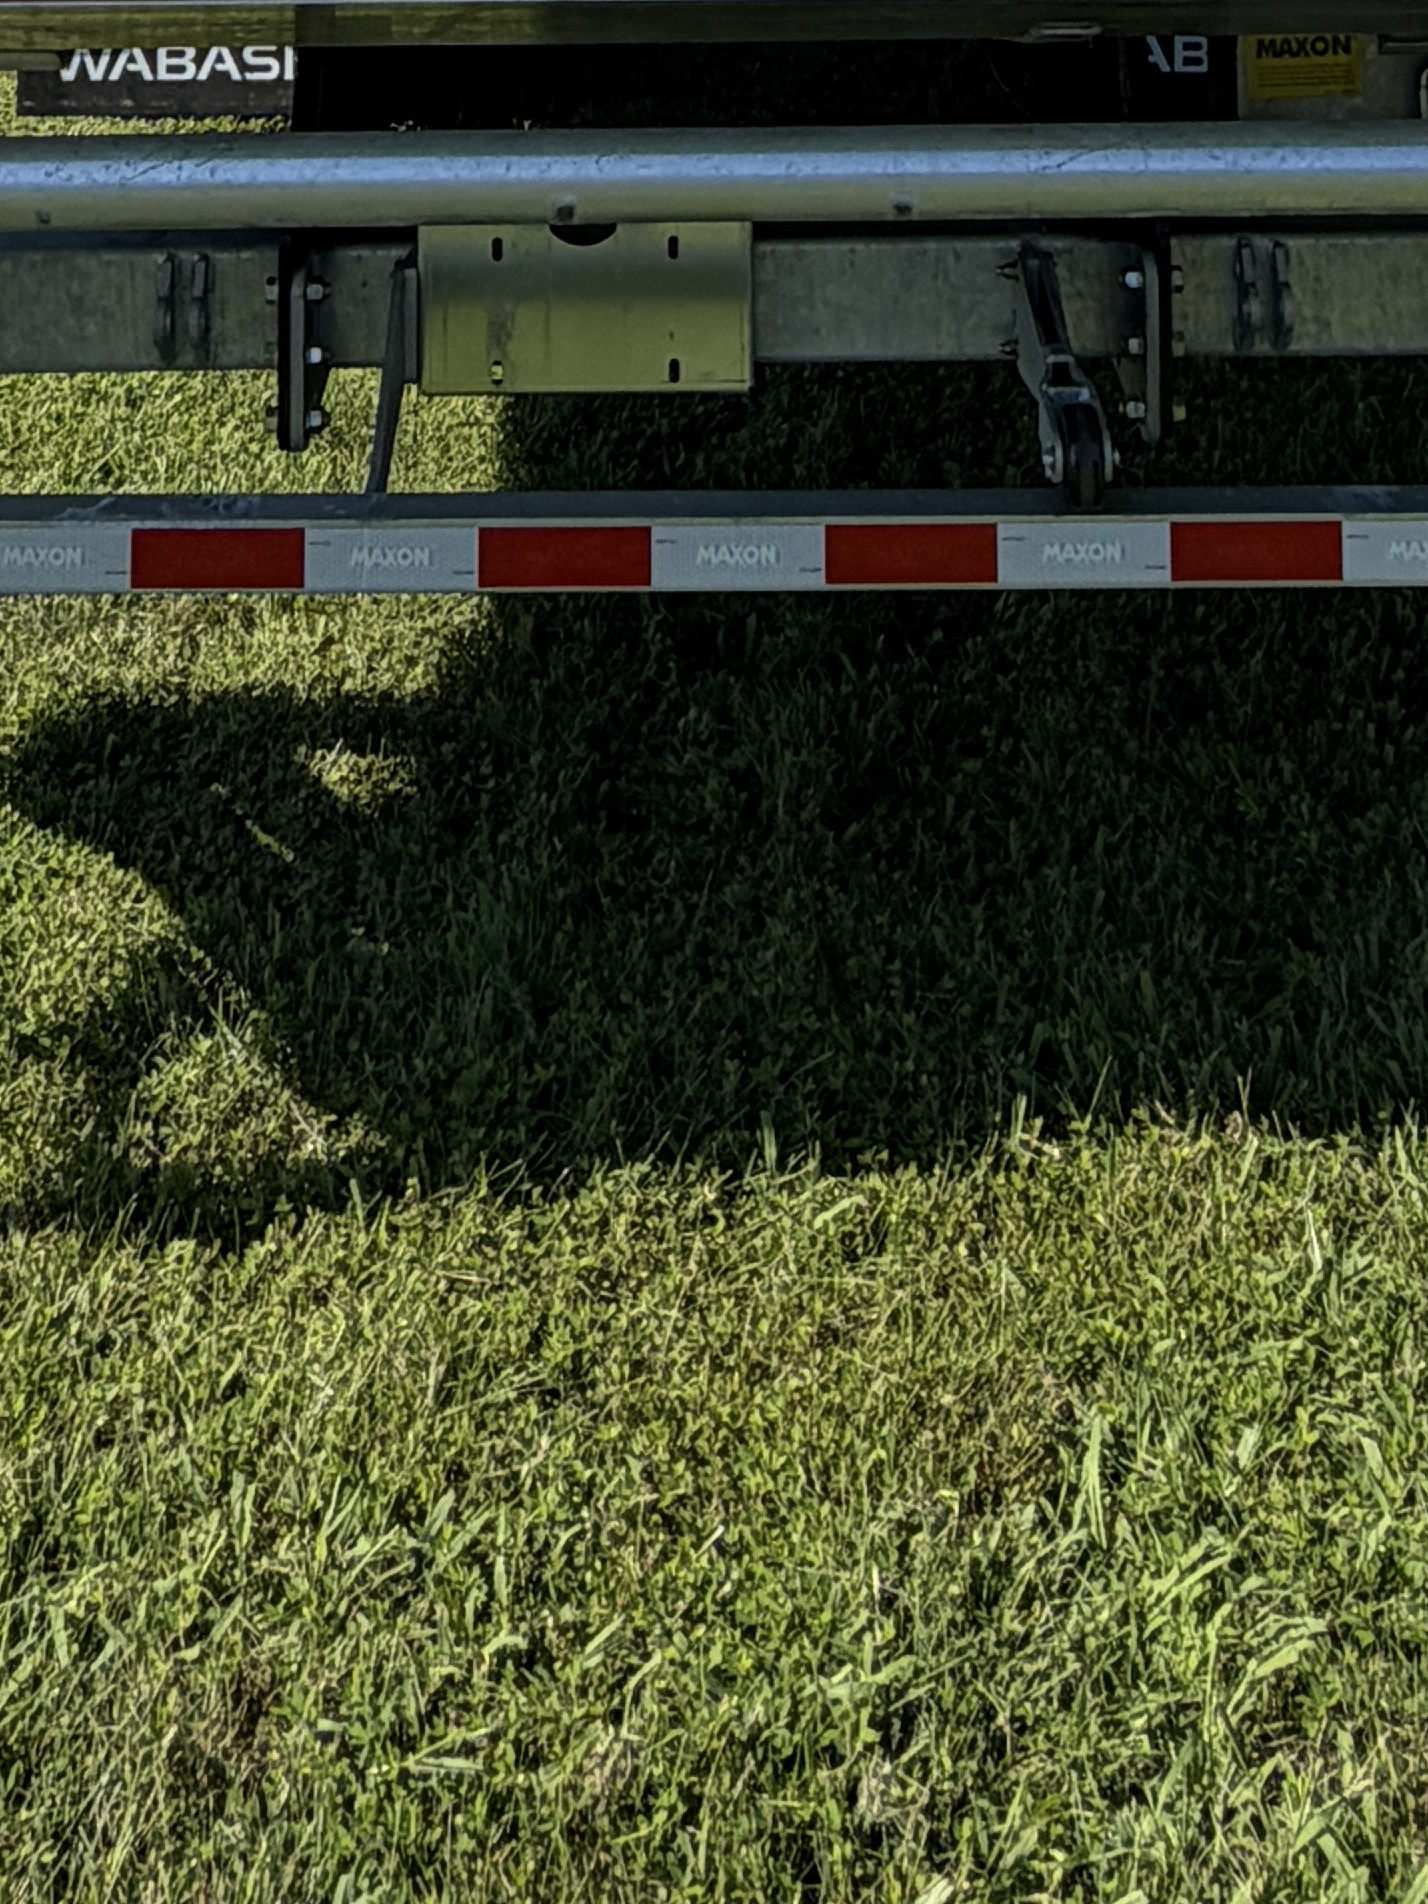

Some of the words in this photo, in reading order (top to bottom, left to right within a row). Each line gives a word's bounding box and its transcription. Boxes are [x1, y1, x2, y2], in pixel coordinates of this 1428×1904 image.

[1255, 34, 1352, 59] MAXON
[1, 545, 83, 568] MAXON
[349, 546, 431, 568] MAXON
[695, 543, 778, 565] MAXON
[1042, 542, 1122, 564] MAXON
